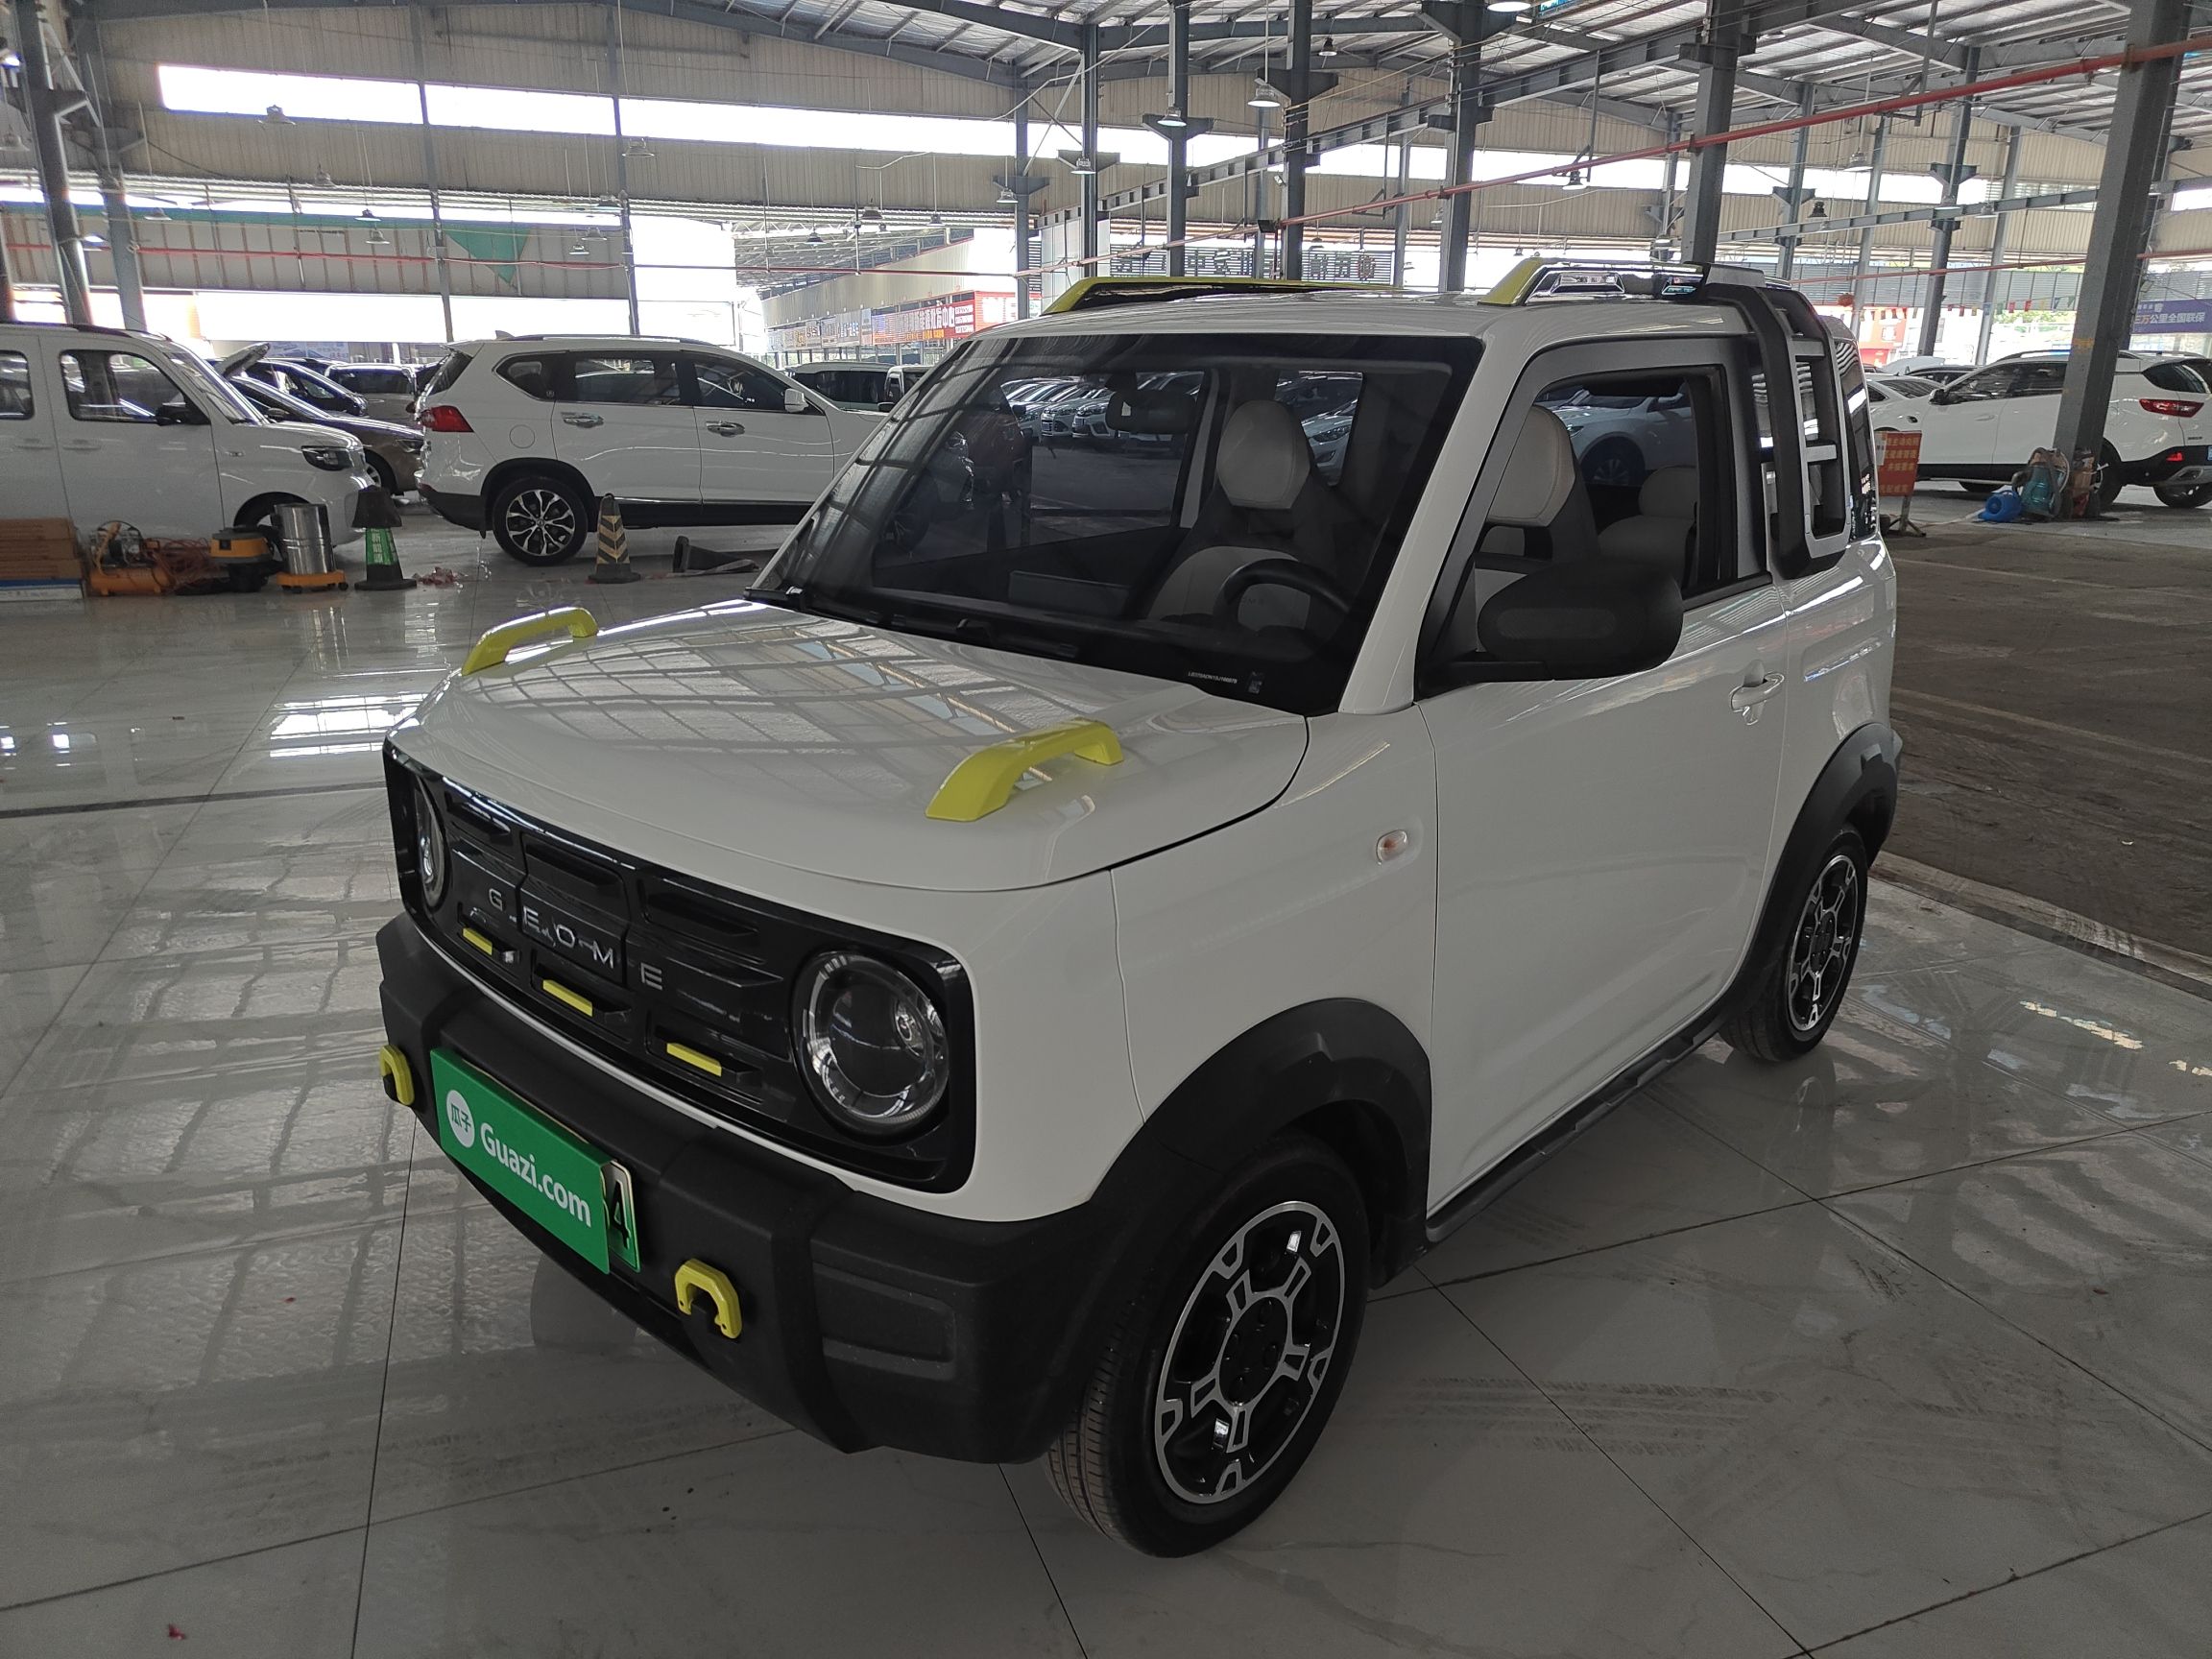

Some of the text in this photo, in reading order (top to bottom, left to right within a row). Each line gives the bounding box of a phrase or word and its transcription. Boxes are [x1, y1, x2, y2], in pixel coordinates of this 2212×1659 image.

[489, 887, 663, 990] GEOME
[450, 1102, 592, 1228] 瓜子 Guazi.com
[613, 1180, 631, 1250] 4
